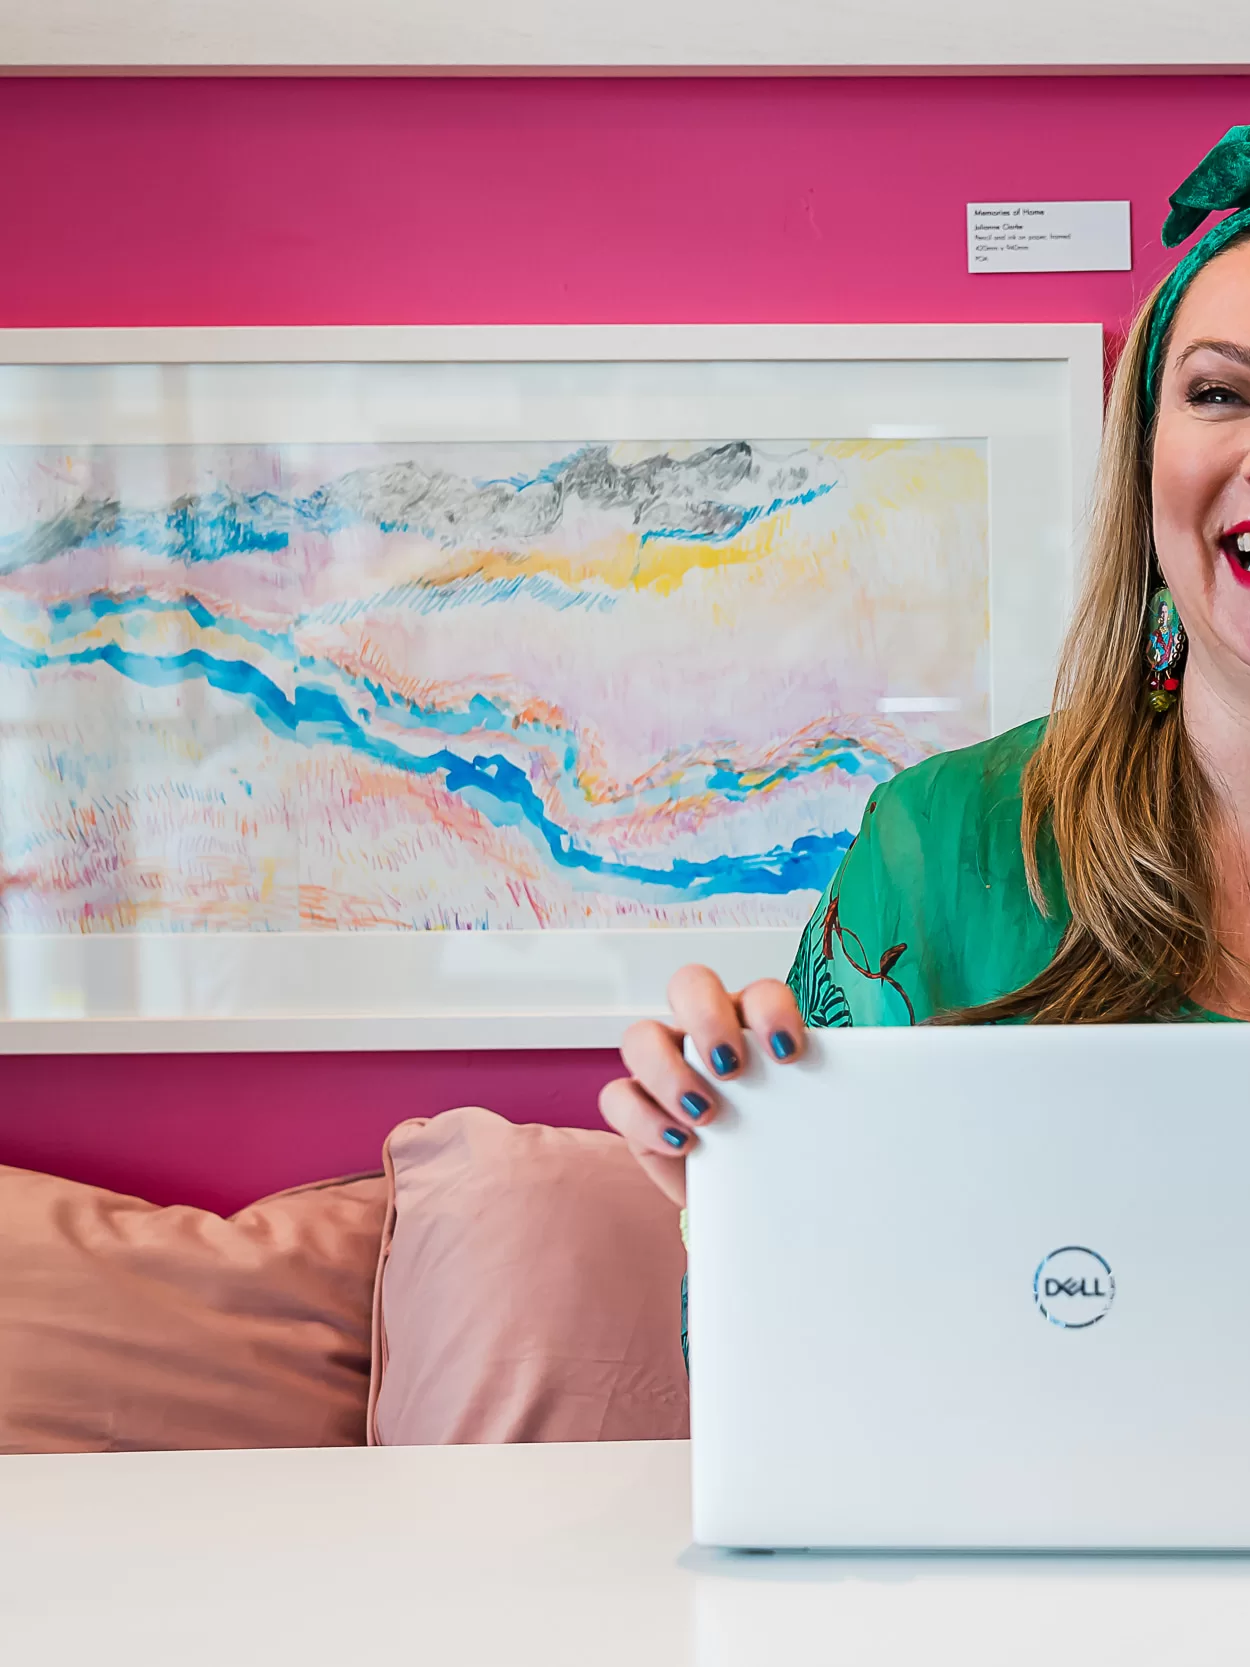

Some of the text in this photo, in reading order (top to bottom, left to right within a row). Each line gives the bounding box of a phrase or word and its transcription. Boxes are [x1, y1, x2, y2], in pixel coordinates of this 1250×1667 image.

[974, 207, 1045, 216] Memories of Home
[1044, 1276, 1106, 1297] DELL
